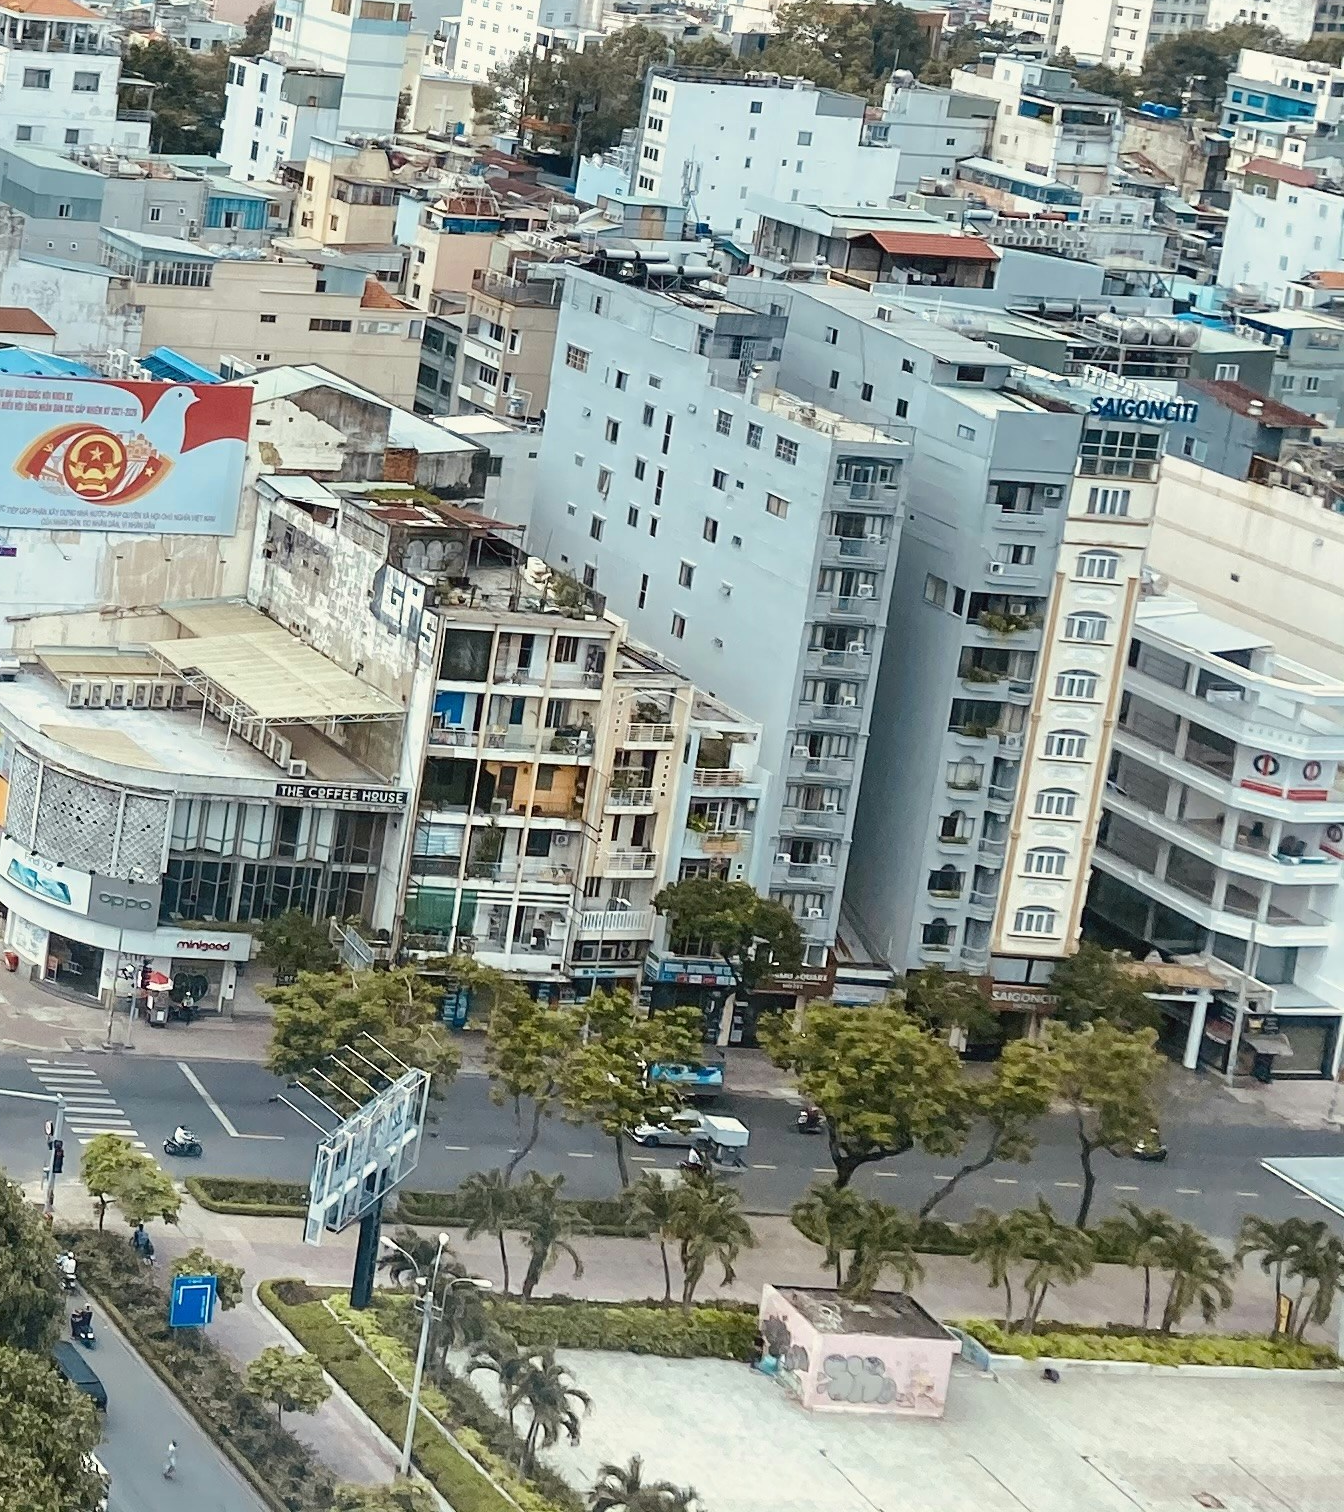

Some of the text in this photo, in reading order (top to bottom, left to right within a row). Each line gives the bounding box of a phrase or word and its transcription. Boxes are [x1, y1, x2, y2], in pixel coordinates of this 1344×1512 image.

[1090, 396, 1199, 423] SAIGONCITI
[280, 785, 404, 804] THE COFFEE HOUSE
[24, 852, 41, 866] Find
[177, 940, 230, 951] minigood
